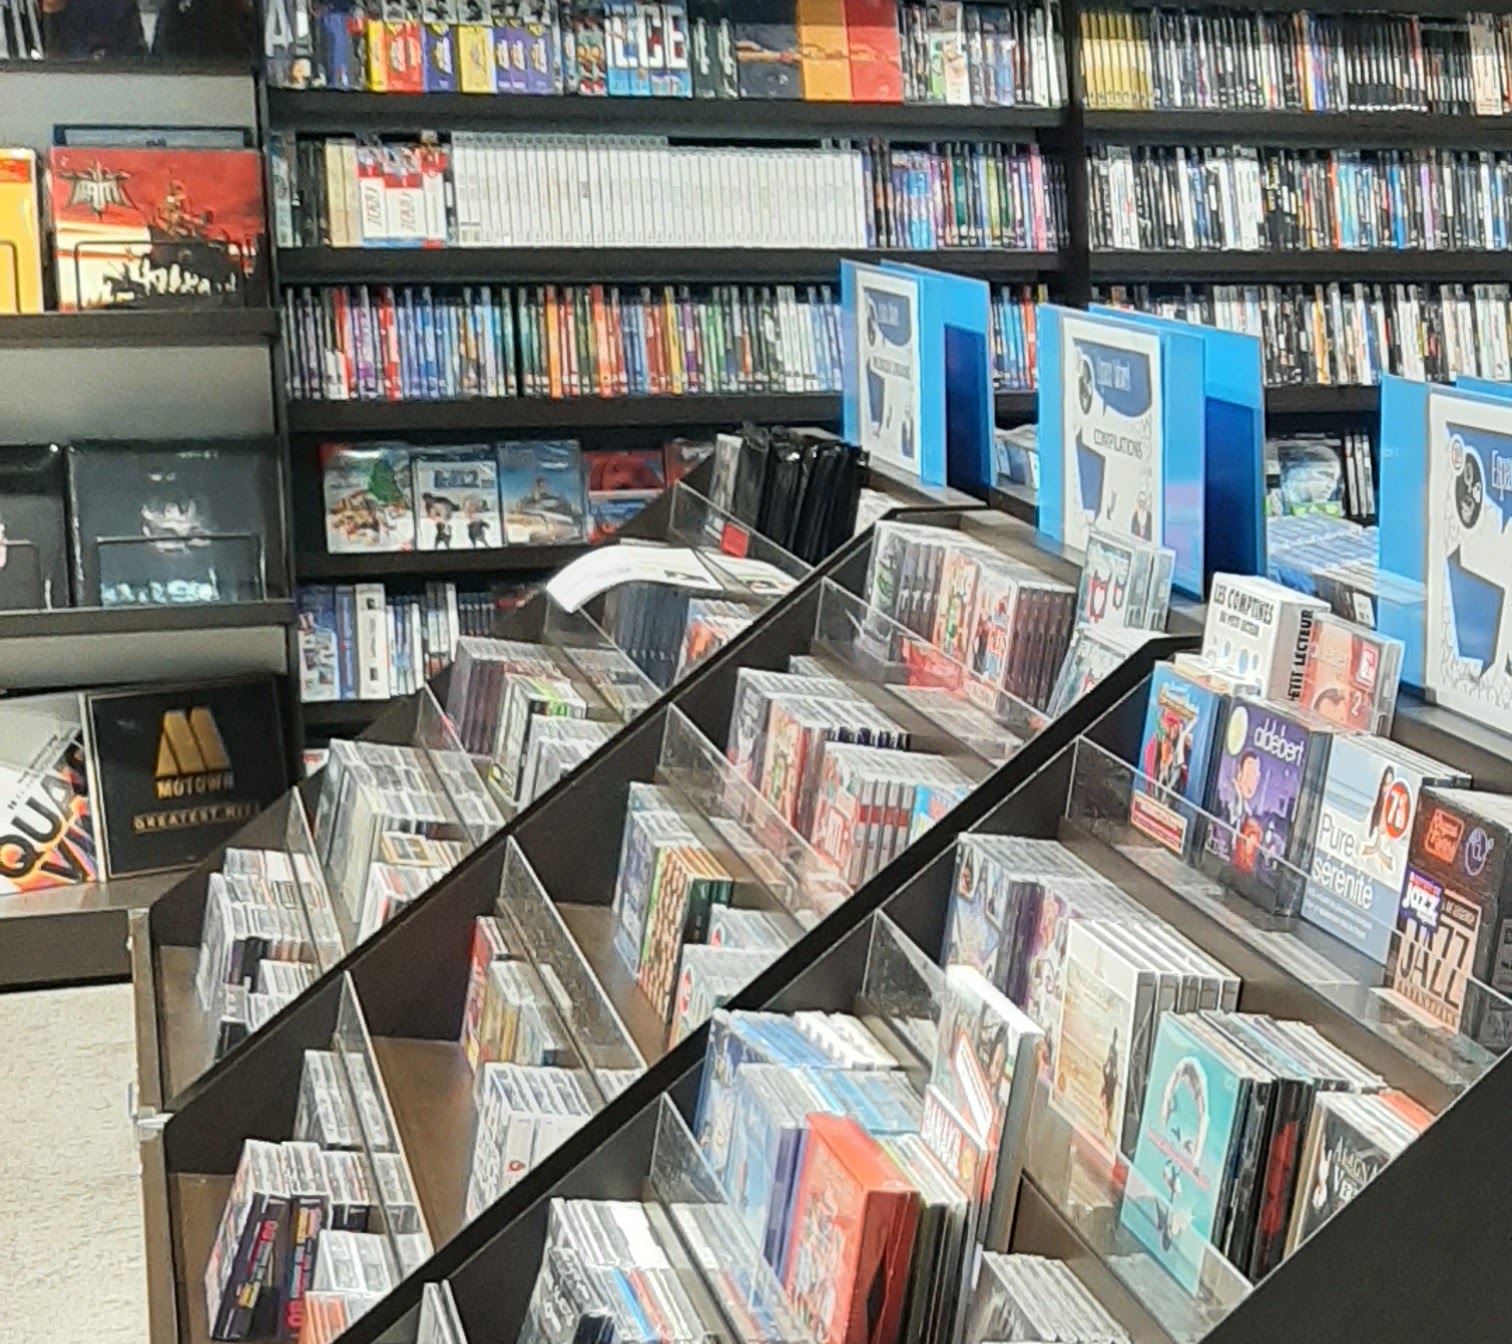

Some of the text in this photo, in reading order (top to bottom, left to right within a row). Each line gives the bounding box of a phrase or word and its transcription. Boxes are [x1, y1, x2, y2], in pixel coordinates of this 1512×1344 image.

[1227, 587, 1275, 626] COMPTINES
[156, 770, 235, 798] MOTOWN
[1319, 812, 1355, 857] Pure
[1312, 853, 1374, 910] sérénité
